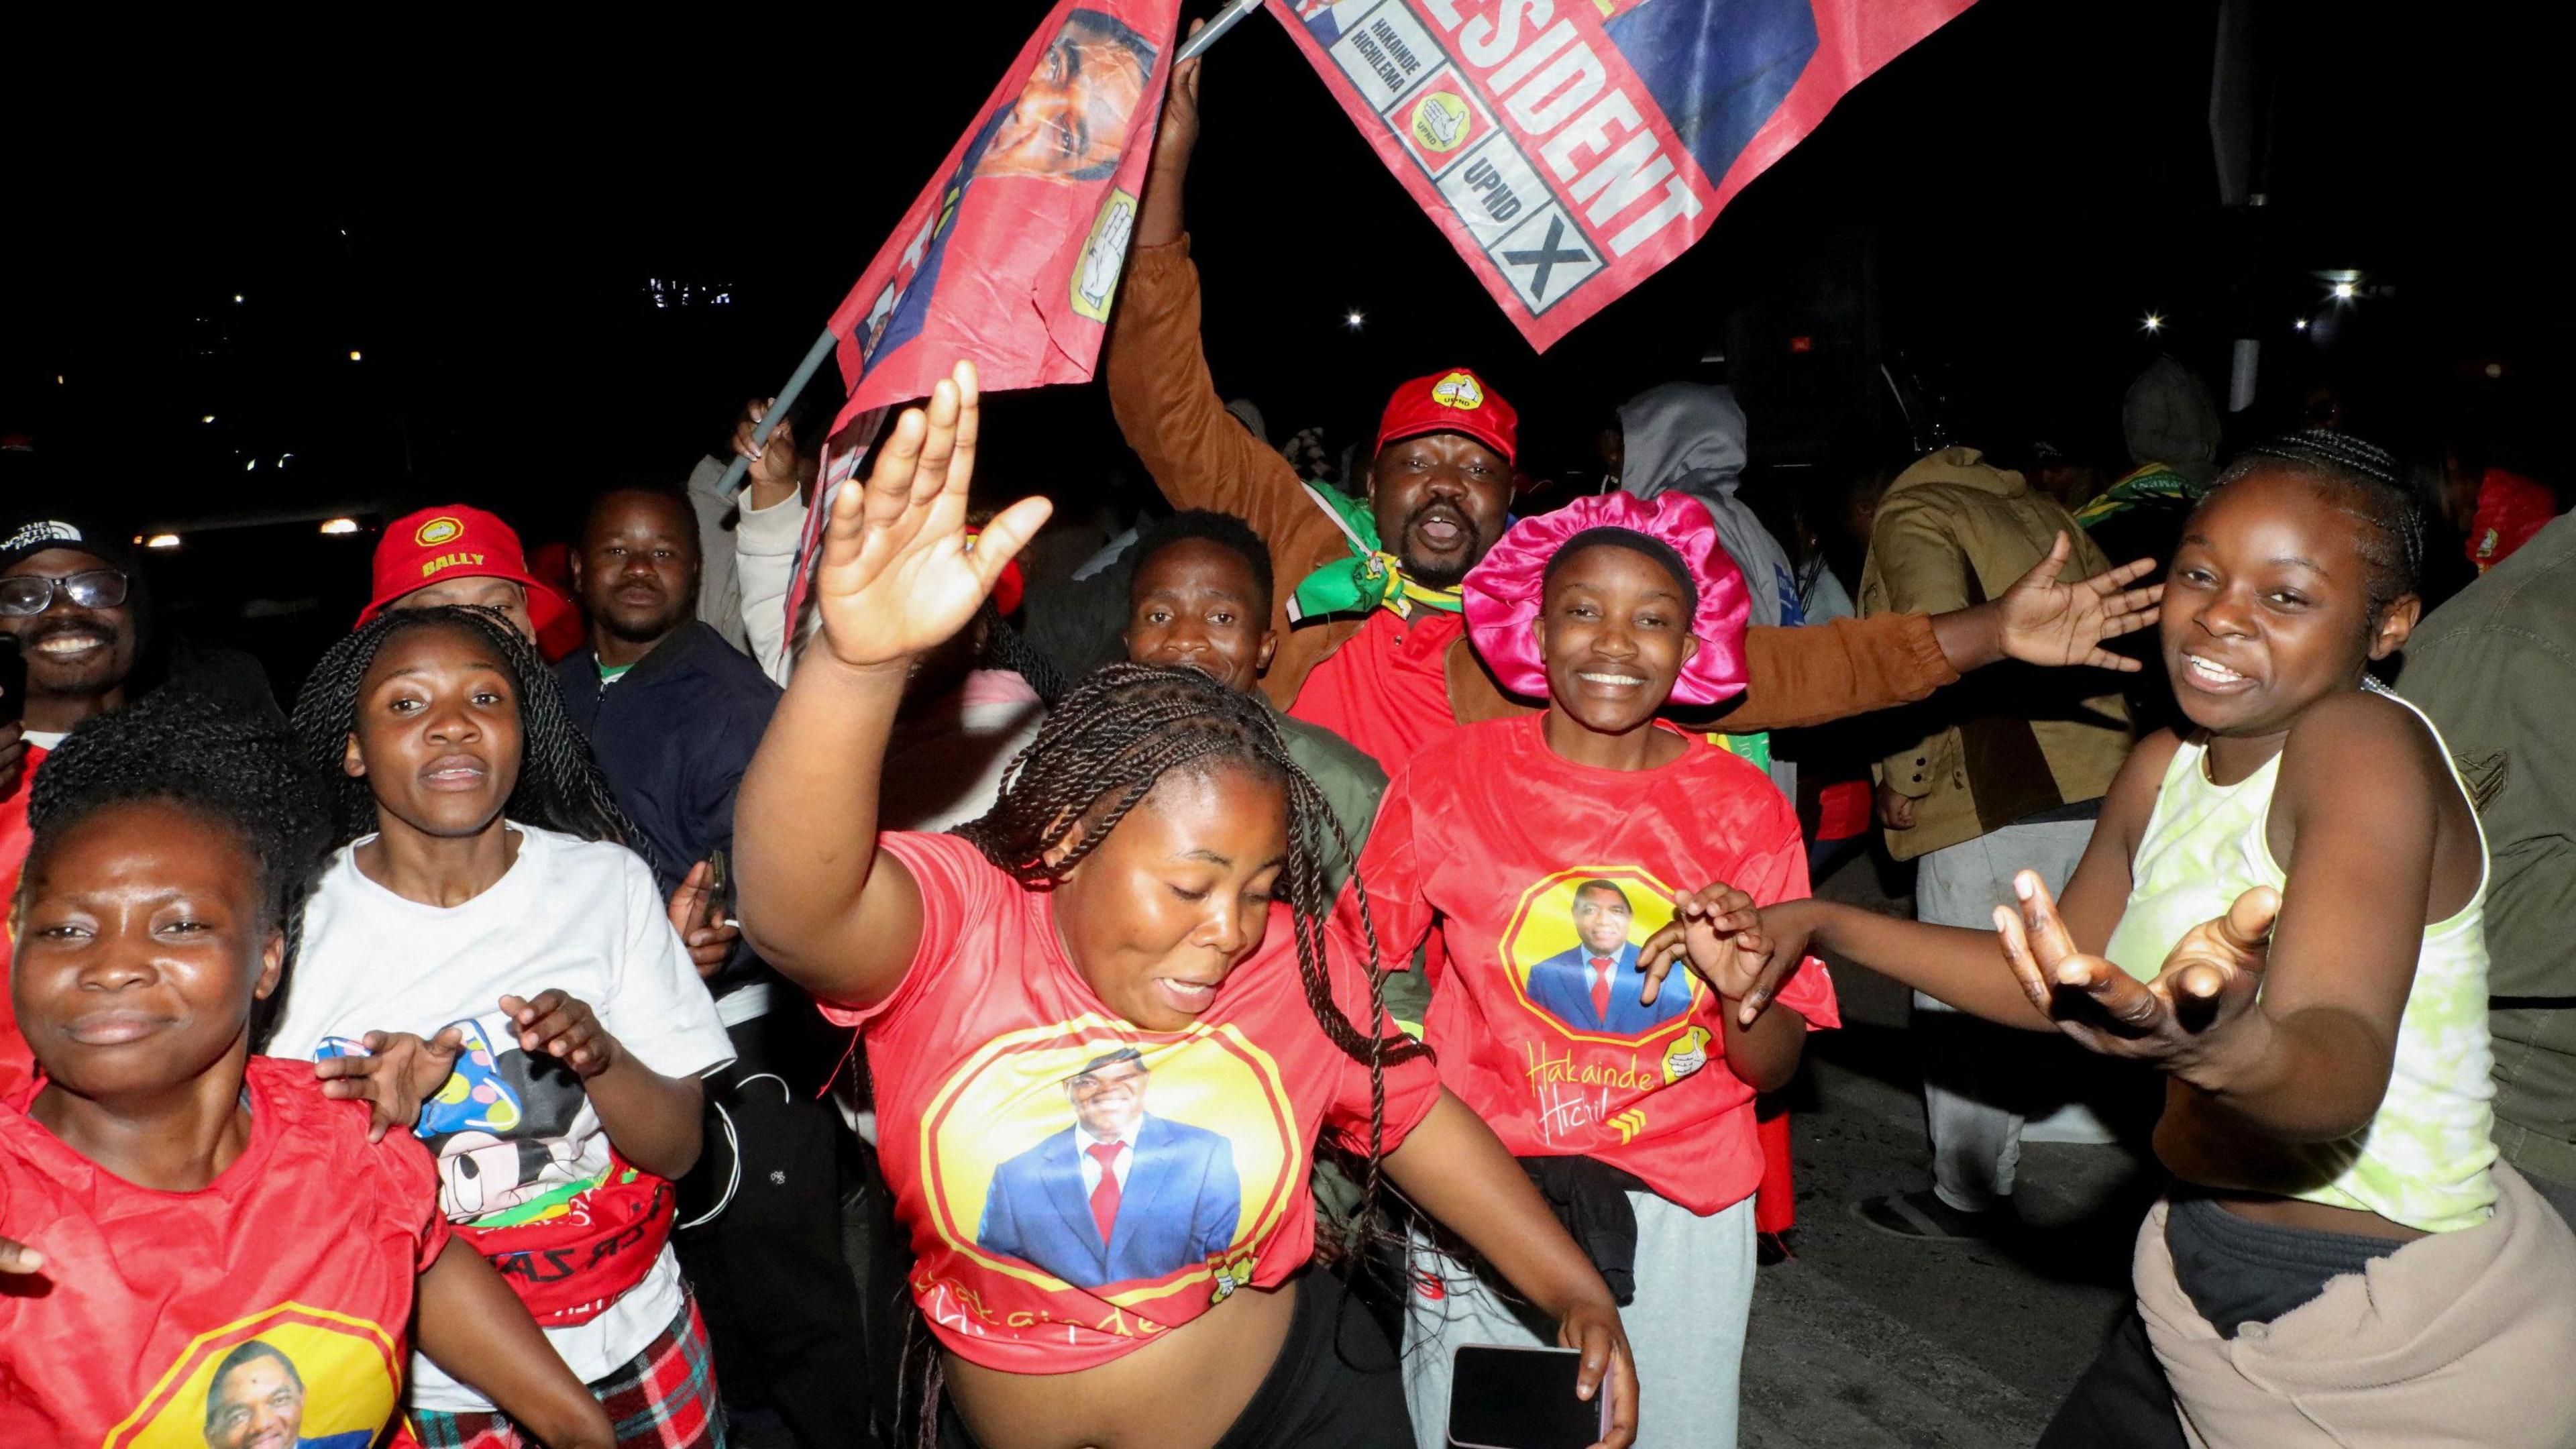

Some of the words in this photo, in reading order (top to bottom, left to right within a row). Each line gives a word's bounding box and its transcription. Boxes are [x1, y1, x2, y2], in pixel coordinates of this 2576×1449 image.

[1350, 30, 1405, 93] HICHILEMA
[1371, 17, 1421, 76] HAKAINDE
[1417, 121, 1436, 145] UPND
[1421, 0, 1703, 258] SIDENT
[1464, 157, 1521, 223] UPND
[422, 553, 484, 577] BALLY
[1525, 1040, 1655, 1098] Hakainde
[1538, 1083, 1622, 1146] Hichil
